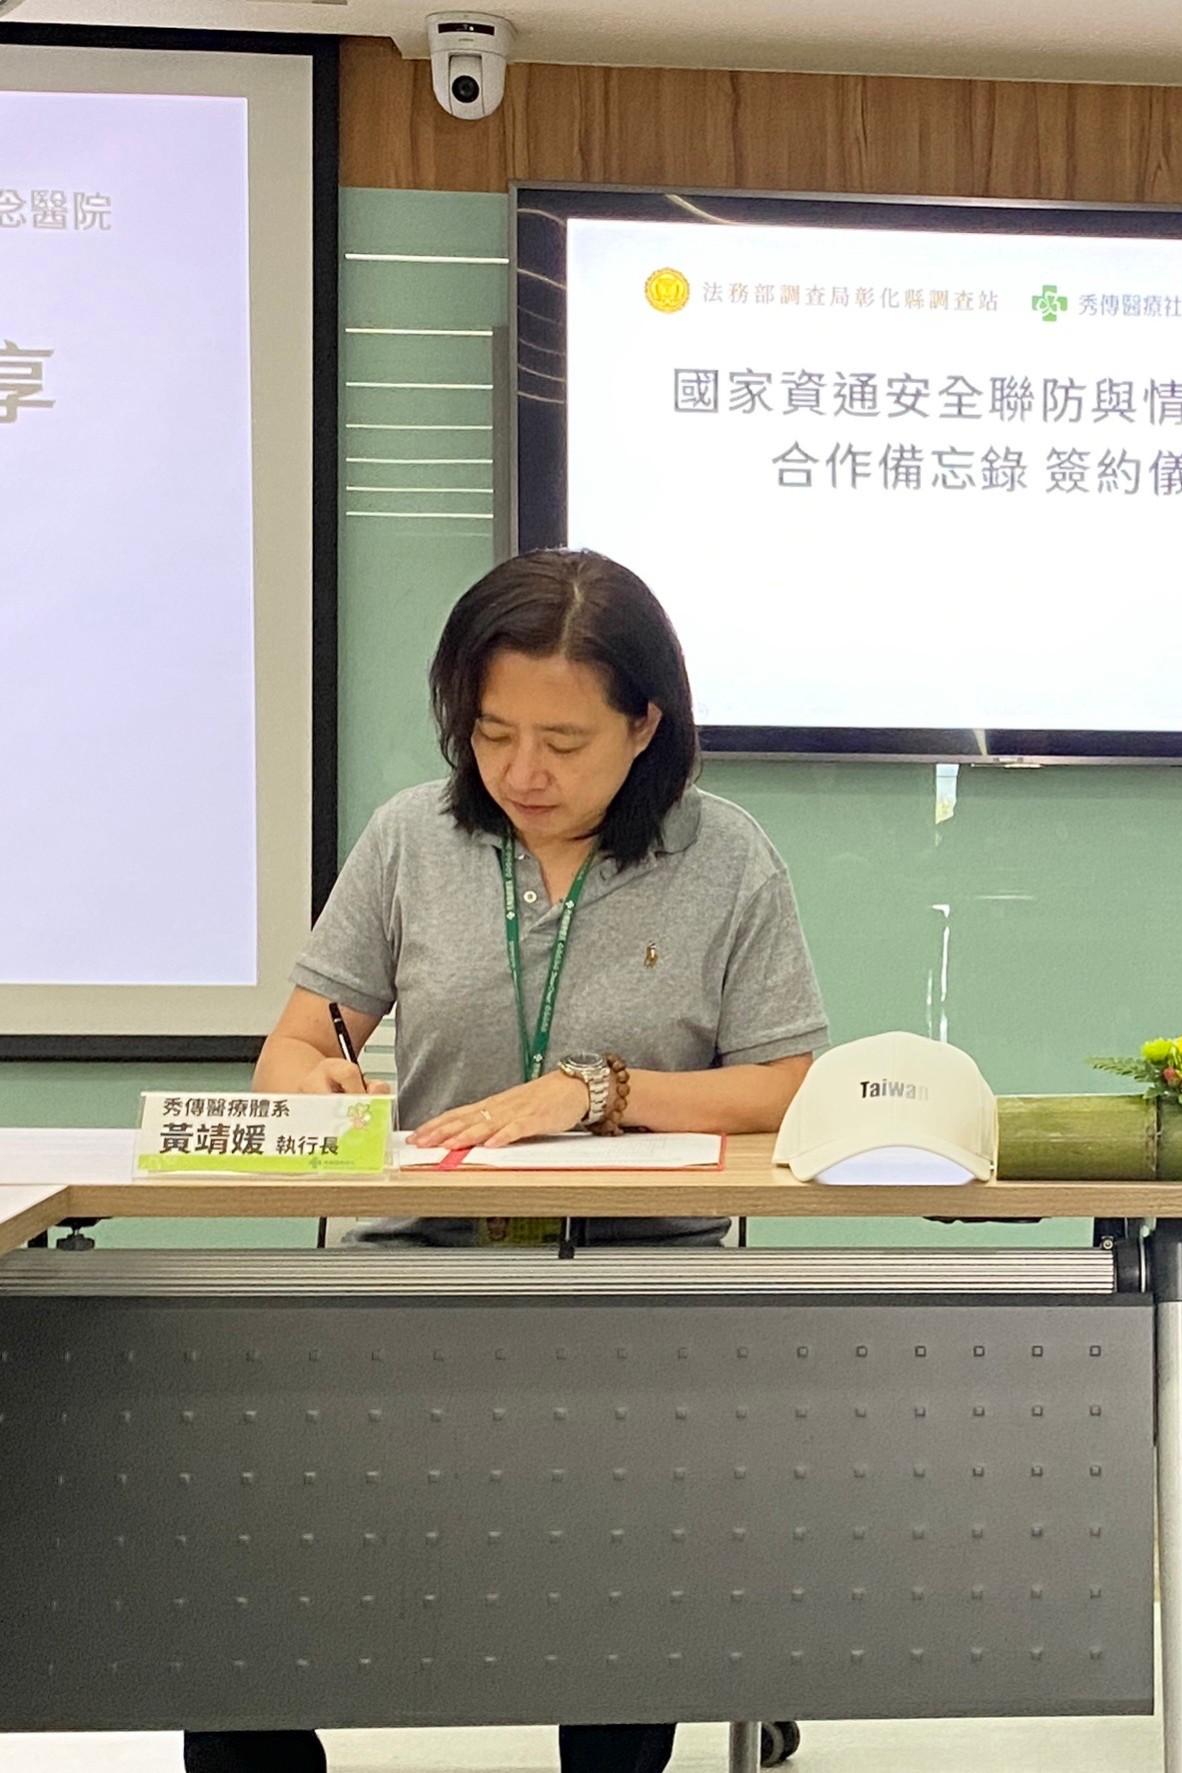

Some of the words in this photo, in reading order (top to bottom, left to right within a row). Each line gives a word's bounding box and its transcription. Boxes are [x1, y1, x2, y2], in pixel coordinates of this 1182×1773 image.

[0, 189, 111, 230] 念醫院
[703, 281, 999, 312] 法務部調查局彰化縣調查站
[772, 441, 1028, 493] 合作備忘錄
[860, 1079, 929, 1101] Taiwan
[163, 1098, 290, 1118] 秀傳醫療體系
[160, 1122, 266, 1155] 黃靖媛
[276, 1135, 339, 1155] 執行長
